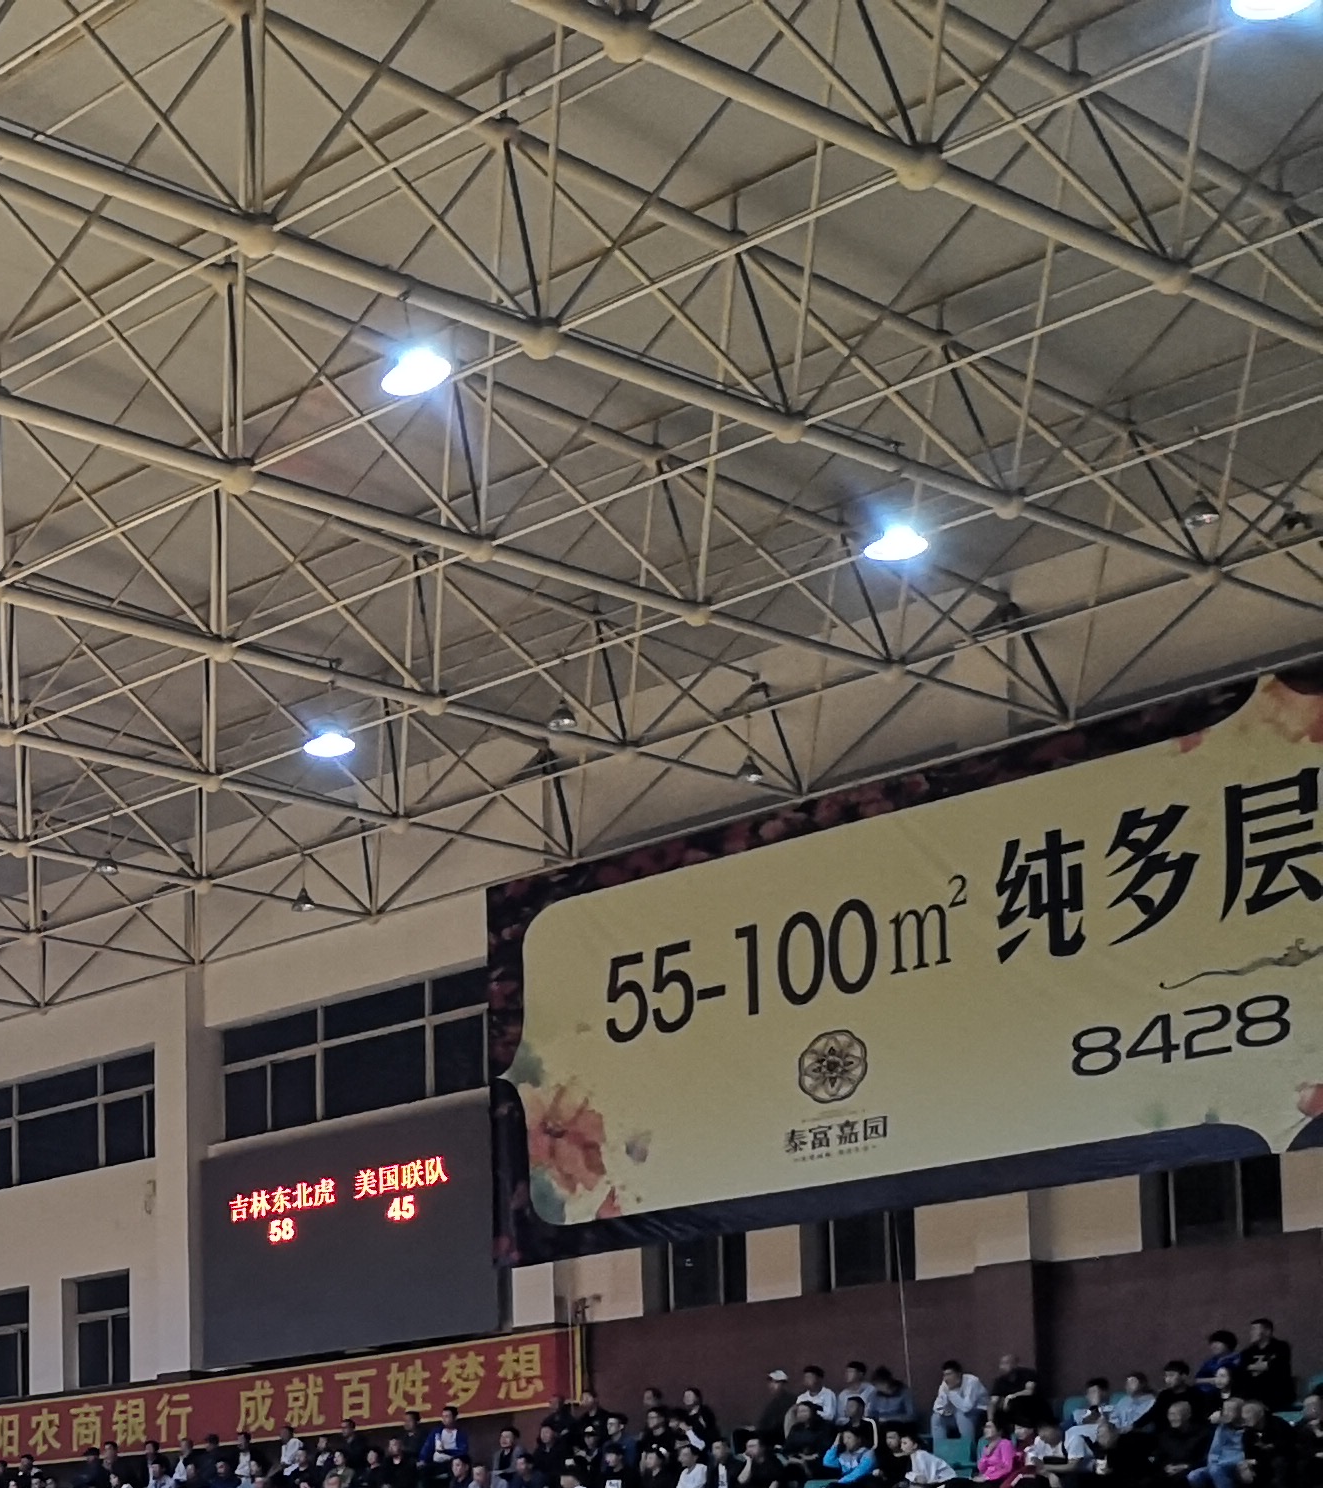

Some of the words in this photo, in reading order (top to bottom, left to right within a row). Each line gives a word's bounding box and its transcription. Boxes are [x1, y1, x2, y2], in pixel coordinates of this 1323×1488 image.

[995, 767, 1323, 964] 纯多层
[1071, 994, 1290, 1076] 8428
[785, 1115, 888, 1153] 泰富嘉园
[229, 1177, 336, 1223] 吉林东北虎
[353, 1156, 449, 1200] 美国联队
[386, 1195, 415, 1221] 45
[268, 1217, 296, 1244] 58
[236, 1344, 545, 1433] 成就百姓梦想
